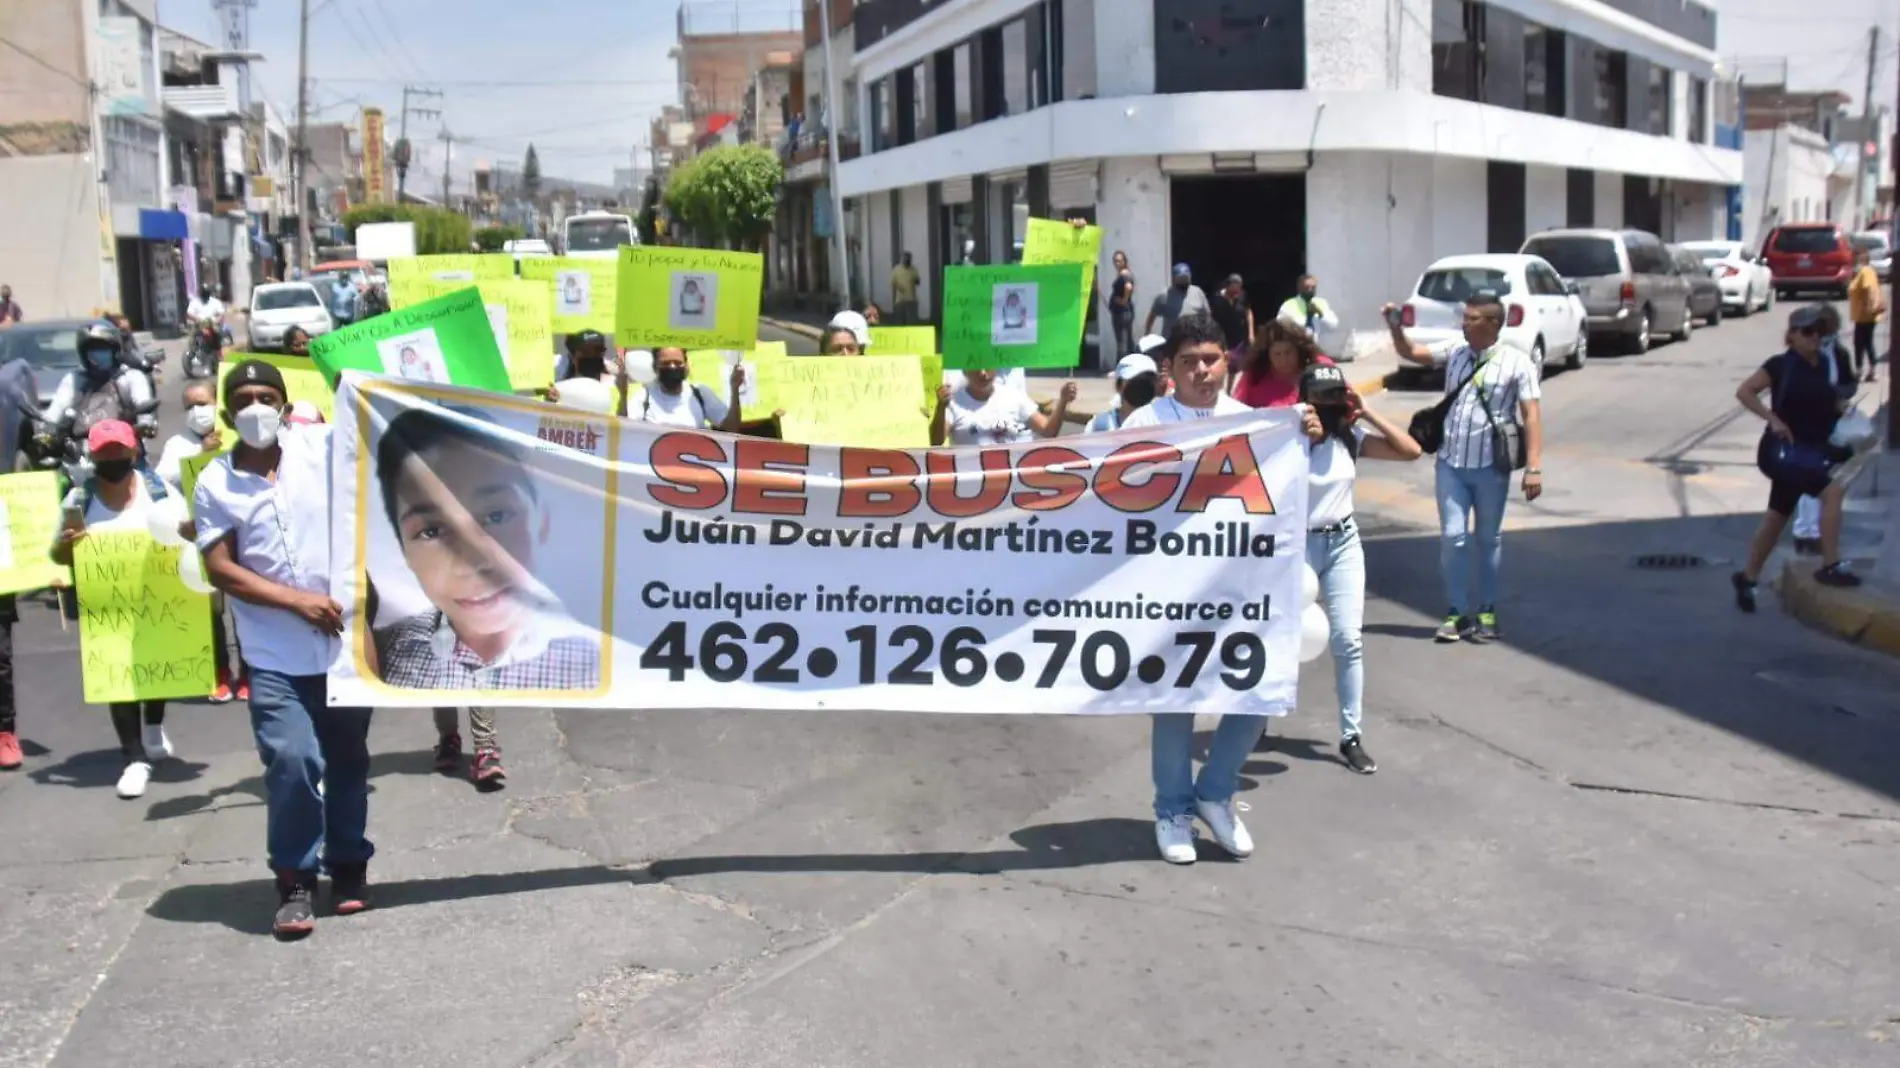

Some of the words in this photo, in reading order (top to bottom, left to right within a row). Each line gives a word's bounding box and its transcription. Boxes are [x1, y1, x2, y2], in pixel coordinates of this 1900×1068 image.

[646, 431, 809, 516] SE
[836, 433, 1276, 518] BUSCA
[643, 511, 756, 545] Juán
[769, 519, 903, 549] David
[912, 516, 1114, 554] Martínez
[1126, 519, 1276, 558] Bonilla
[641, 580, 808, 618] Cualquier
[816, 584, 1015, 616] información
[1023, 593, 1234, 621] comunicarce
[1242, 594, 1271, 621] al
